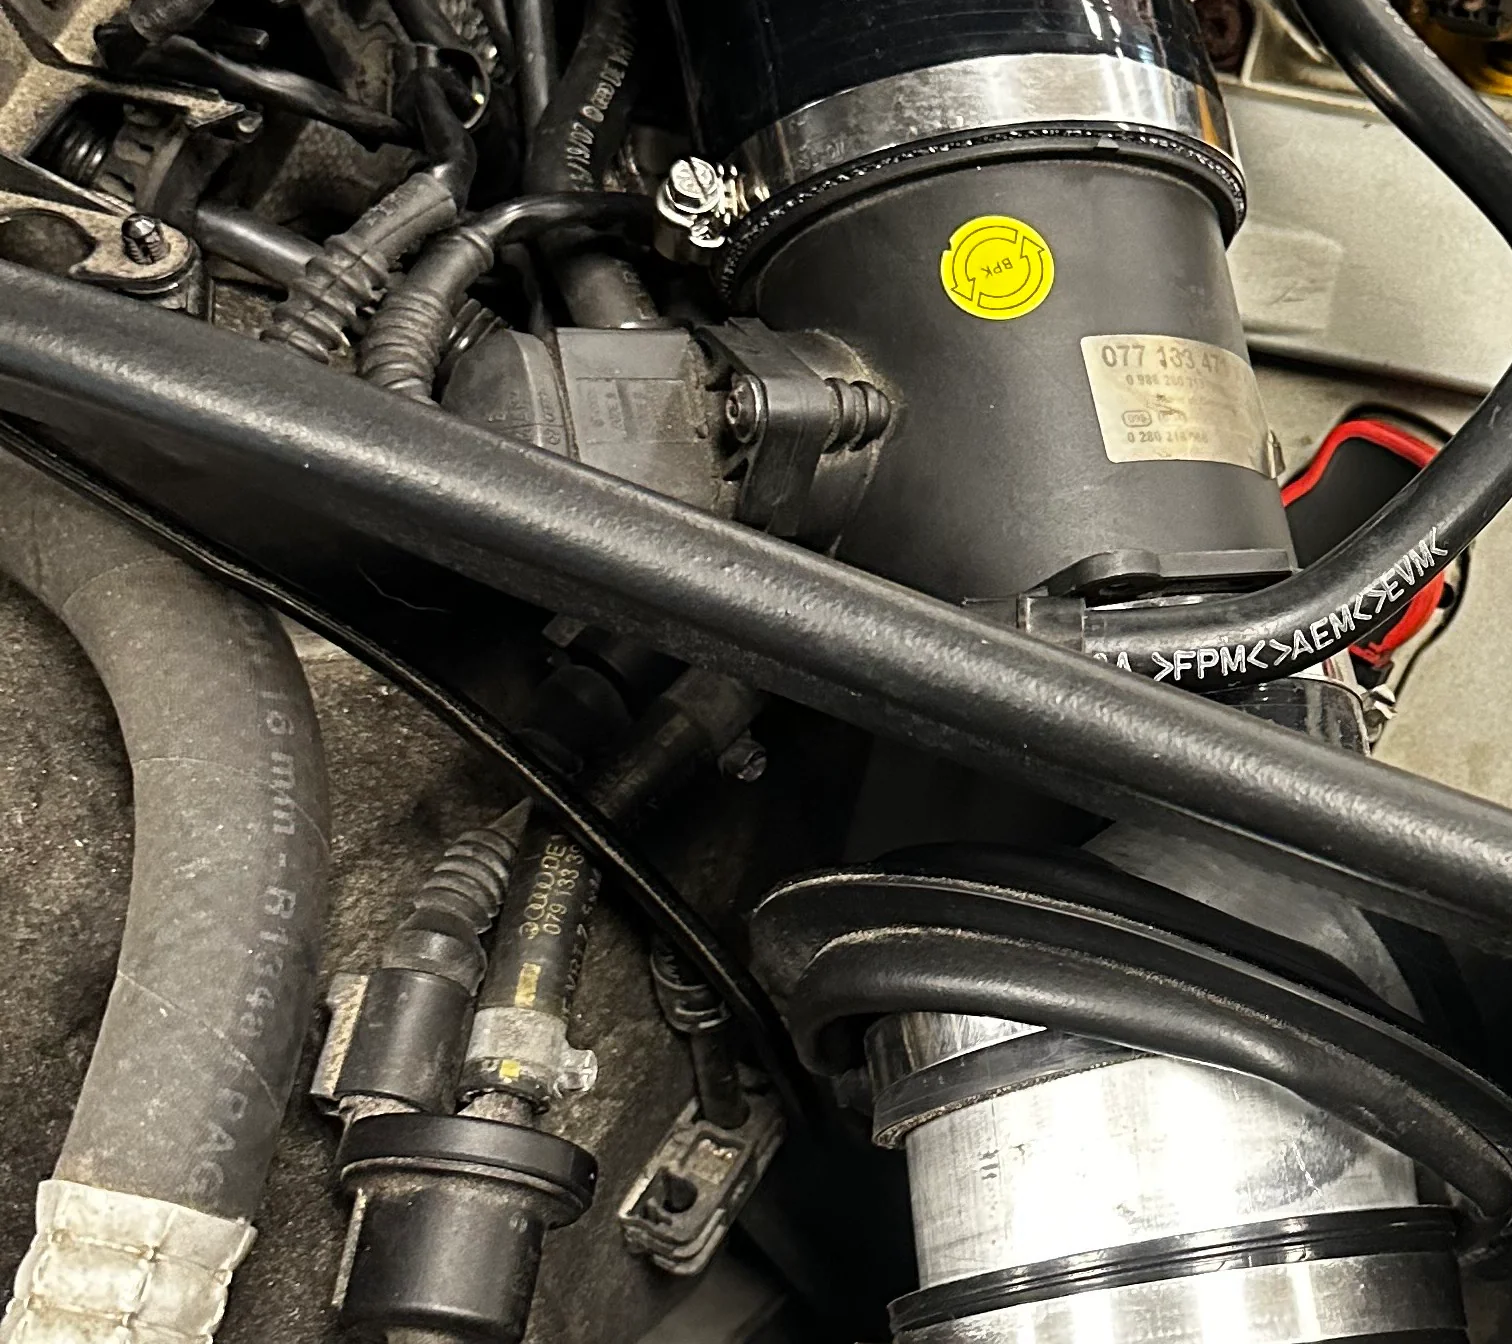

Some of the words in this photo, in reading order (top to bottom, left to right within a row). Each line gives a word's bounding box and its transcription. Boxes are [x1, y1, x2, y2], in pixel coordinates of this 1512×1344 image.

[979, 256, 1014, 279] BPK
[1101, 344, 1146, 368] 077
[1156, 345, 1196, 370] 133
[269, 751, 297, 836] mm
[553, 867, 580, 897] 133
[542, 902, 568, 937] 079
